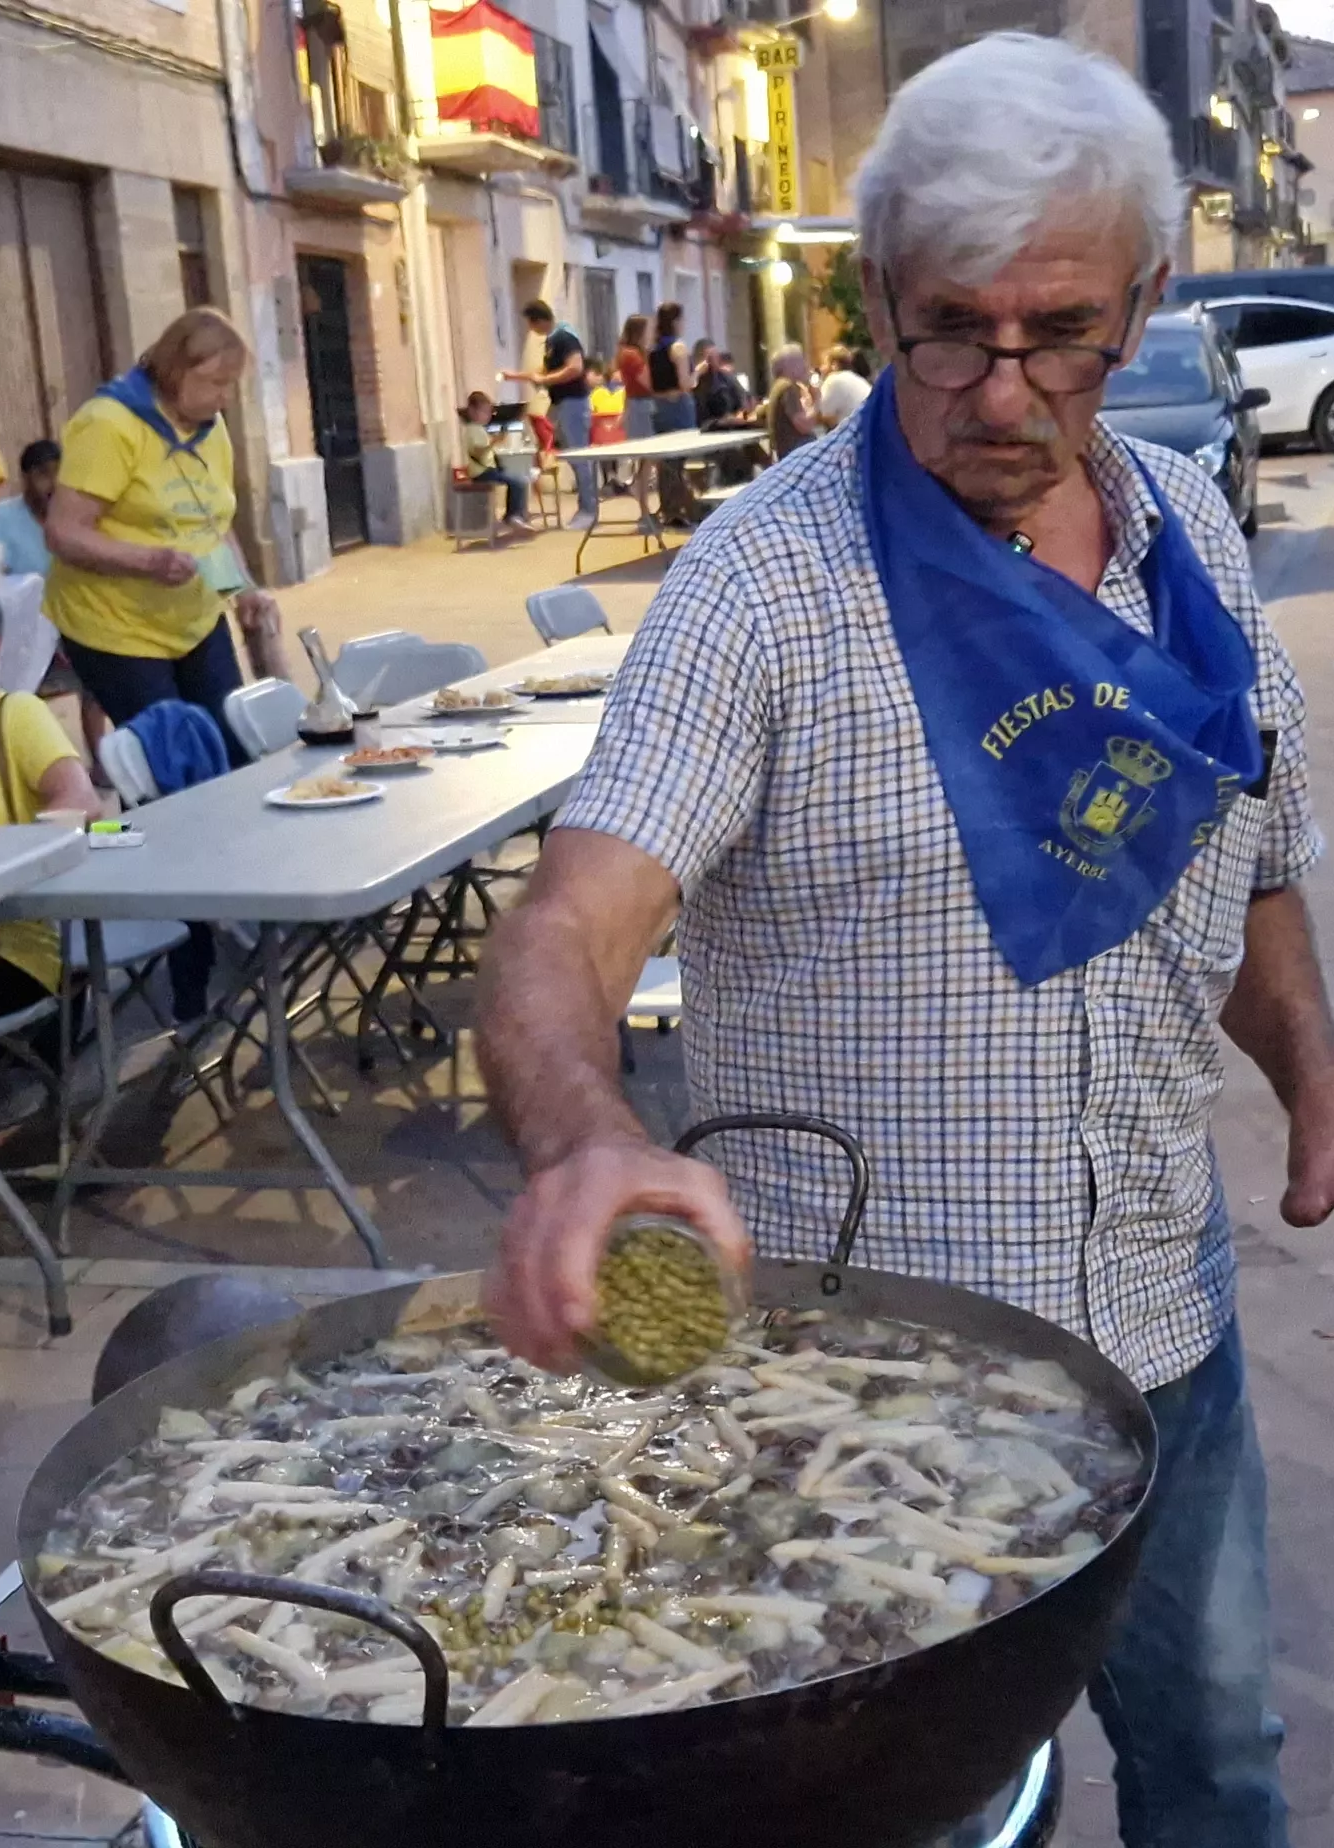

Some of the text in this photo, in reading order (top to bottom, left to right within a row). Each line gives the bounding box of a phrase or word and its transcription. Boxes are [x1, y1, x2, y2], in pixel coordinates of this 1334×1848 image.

[758, 47, 799, 68] BAR
[772, 75, 792, 211] PIRINEOS
[980, 682, 1131, 761] FIESTAS DE
